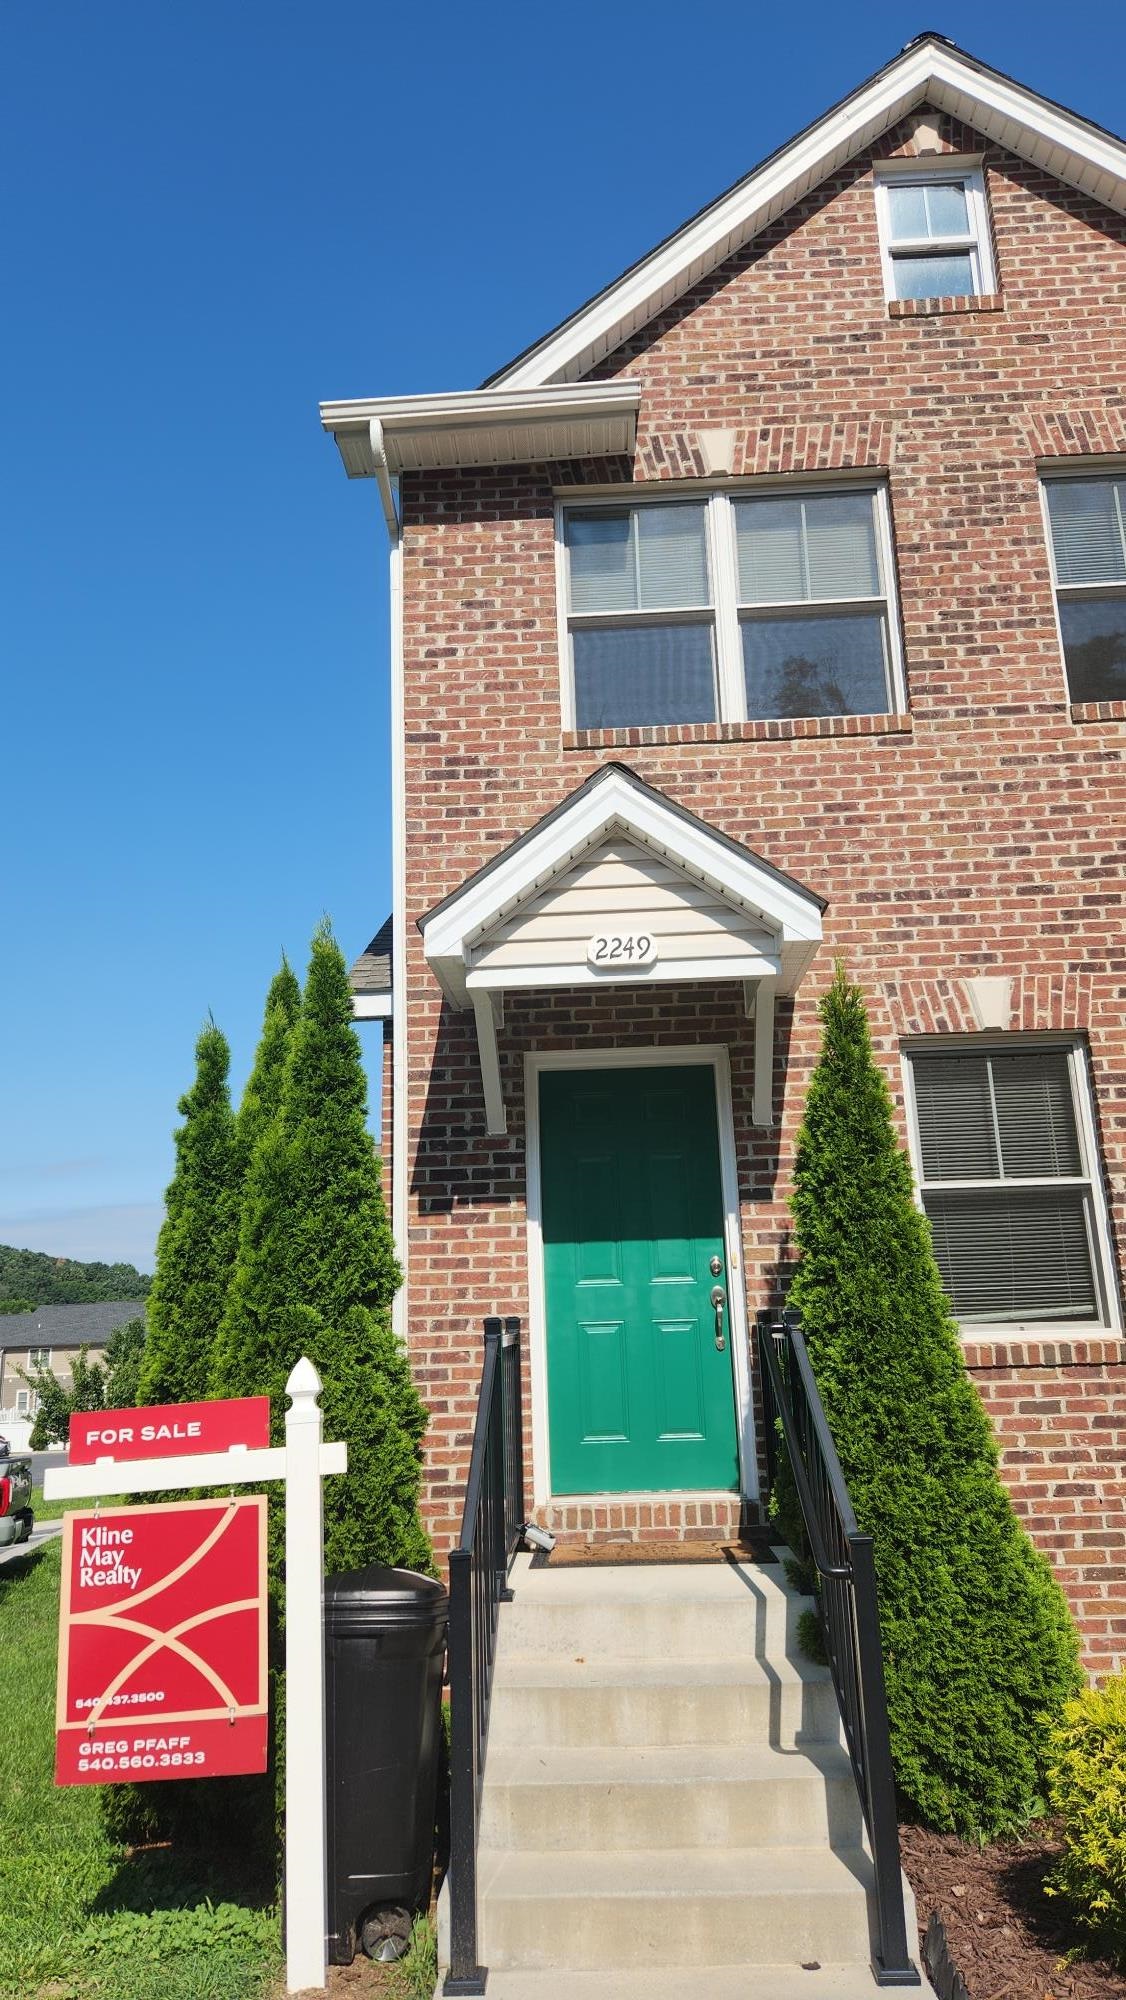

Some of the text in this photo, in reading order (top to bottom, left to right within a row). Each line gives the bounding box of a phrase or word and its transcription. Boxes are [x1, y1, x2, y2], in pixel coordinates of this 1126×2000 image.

[595, 935, 651, 960] 2249
[86, 1421, 202, 1446] FOR SALE
[81, 1526, 134, 1548] Kline
[80, 1547, 124, 1570] May
[79, 1564, 142, 1589] Realty
[78, 1736, 191, 1755] GREG PFAFF
[77, 1751, 205, 1772] 540.560.3833
